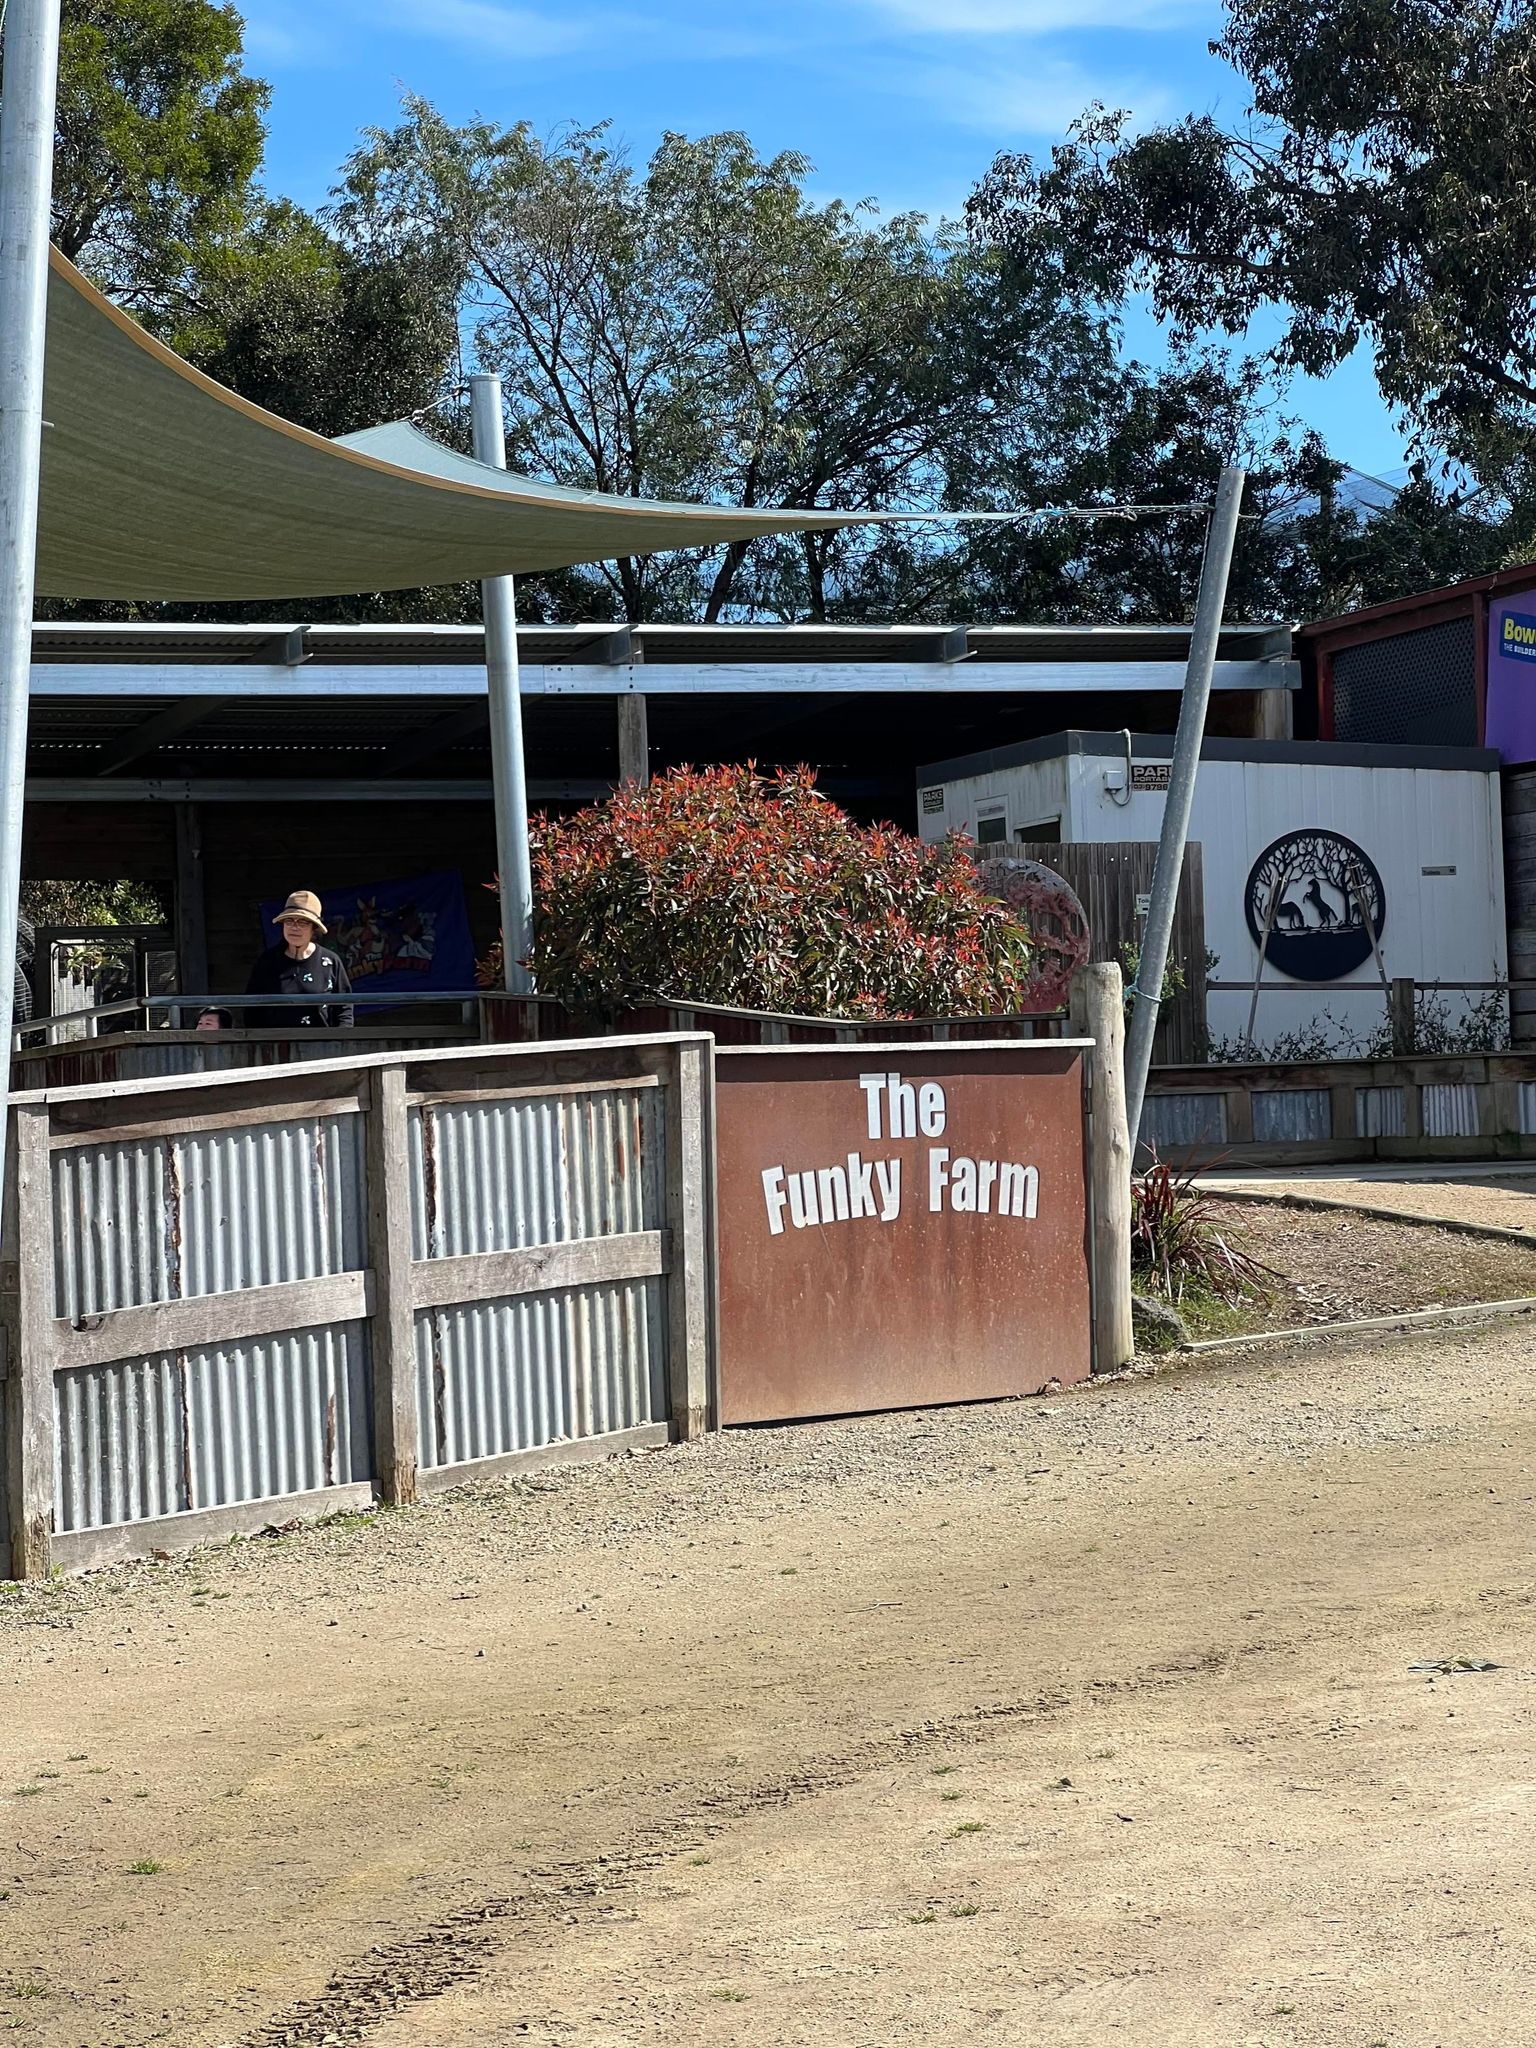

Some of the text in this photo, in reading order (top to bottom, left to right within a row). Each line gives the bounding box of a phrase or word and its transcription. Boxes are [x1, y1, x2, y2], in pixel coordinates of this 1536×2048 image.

[1504, 618, 1536, 644] Bow
[859, 1073, 946, 1139] The
[761, 1148, 1039, 1235] Funky Farm
